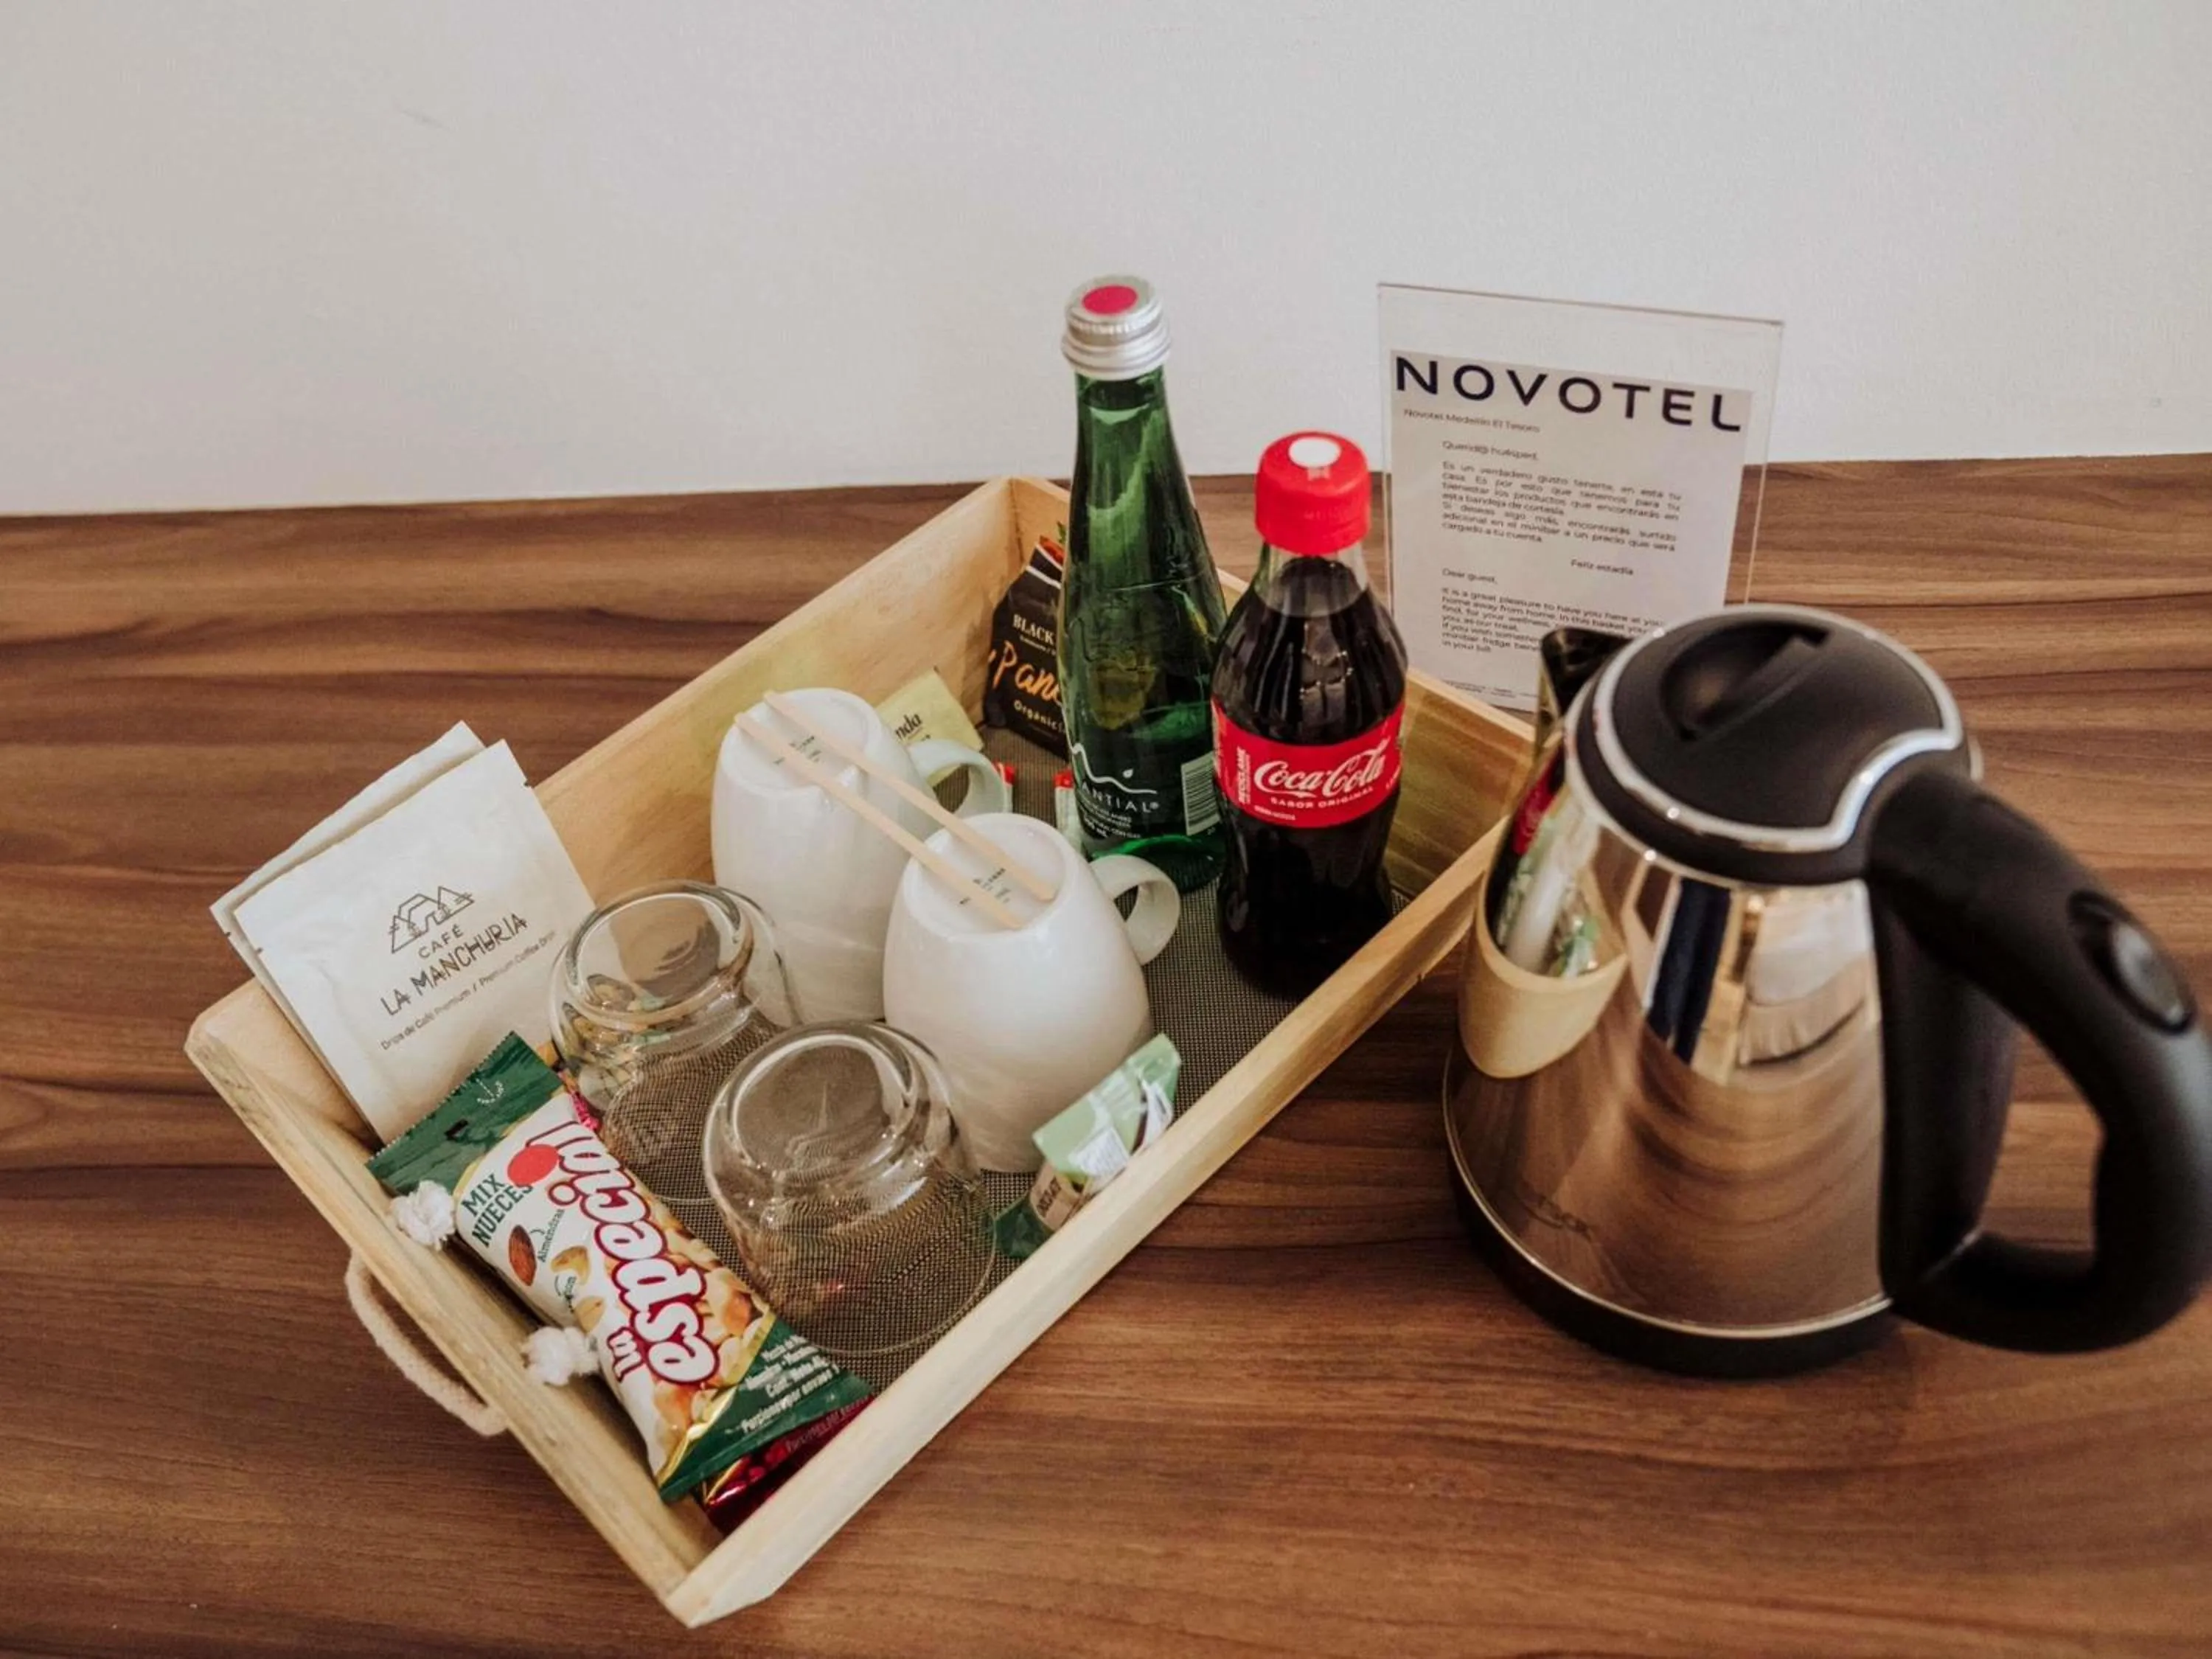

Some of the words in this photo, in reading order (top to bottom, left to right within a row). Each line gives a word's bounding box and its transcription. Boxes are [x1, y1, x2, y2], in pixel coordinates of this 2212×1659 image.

[1396, 357, 1741, 432] NOVOTEL
[1404, 407, 1442, 420] Novotel
[1460, 465, 1475, 473] un
[1481, 466, 1532, 480] verdadero
[1537, 474, 1568, 487] gusto
[1620, 485, 1635, 494] en
[1507, 501, 1522, 509] de
[1514, 491, 1565, 506] productos
[1571, 500, 1591, 510] que
[1520, 481, 1543, 492] esto
[1551, 486, 1571, 497] que
[1580, 490, 1627, 504] tenemos
[1635, 498, 1659, 509] para
[1592, 533, 1625, 546] precio
[1628, 539, 1649, 550] que
[1441, 567, 1465, 578] Dear
[1571, 558, 1593, 569] Feliz
[1441, 595, 1470, 605] home
[1473, 601, 1497, 612] away
[1500, 603, 1523, 613] from
[1483, 611, 1503, 622] your
[1499, 595, 1540, 608] pleasure
[1543, 601, 1555, 611] to
[1557, 604, 1580, 614] have
[1583, 609, 1601, 619] you
[1604, 611, 1627, 622] here
[1012, 613, 1054, 645] BLACK
[1453, 641, 1474, 651] your
[1253, 736, 1391, 798] Coca-Cola
[1270, 796, 1313, 809] SABOR
[1318, 786, 1374, 808] ORIGINAL
[418, 924, 464, 959] CAFÉ
[380, 989, 411, 1016] LA
[410, 913, 528, 996] MANCHURIA
[461, 1171, 504, 1217] MIX
[537, 1208, 566, 1263] Almendras
[524, 1120, 720, 1384] especial
